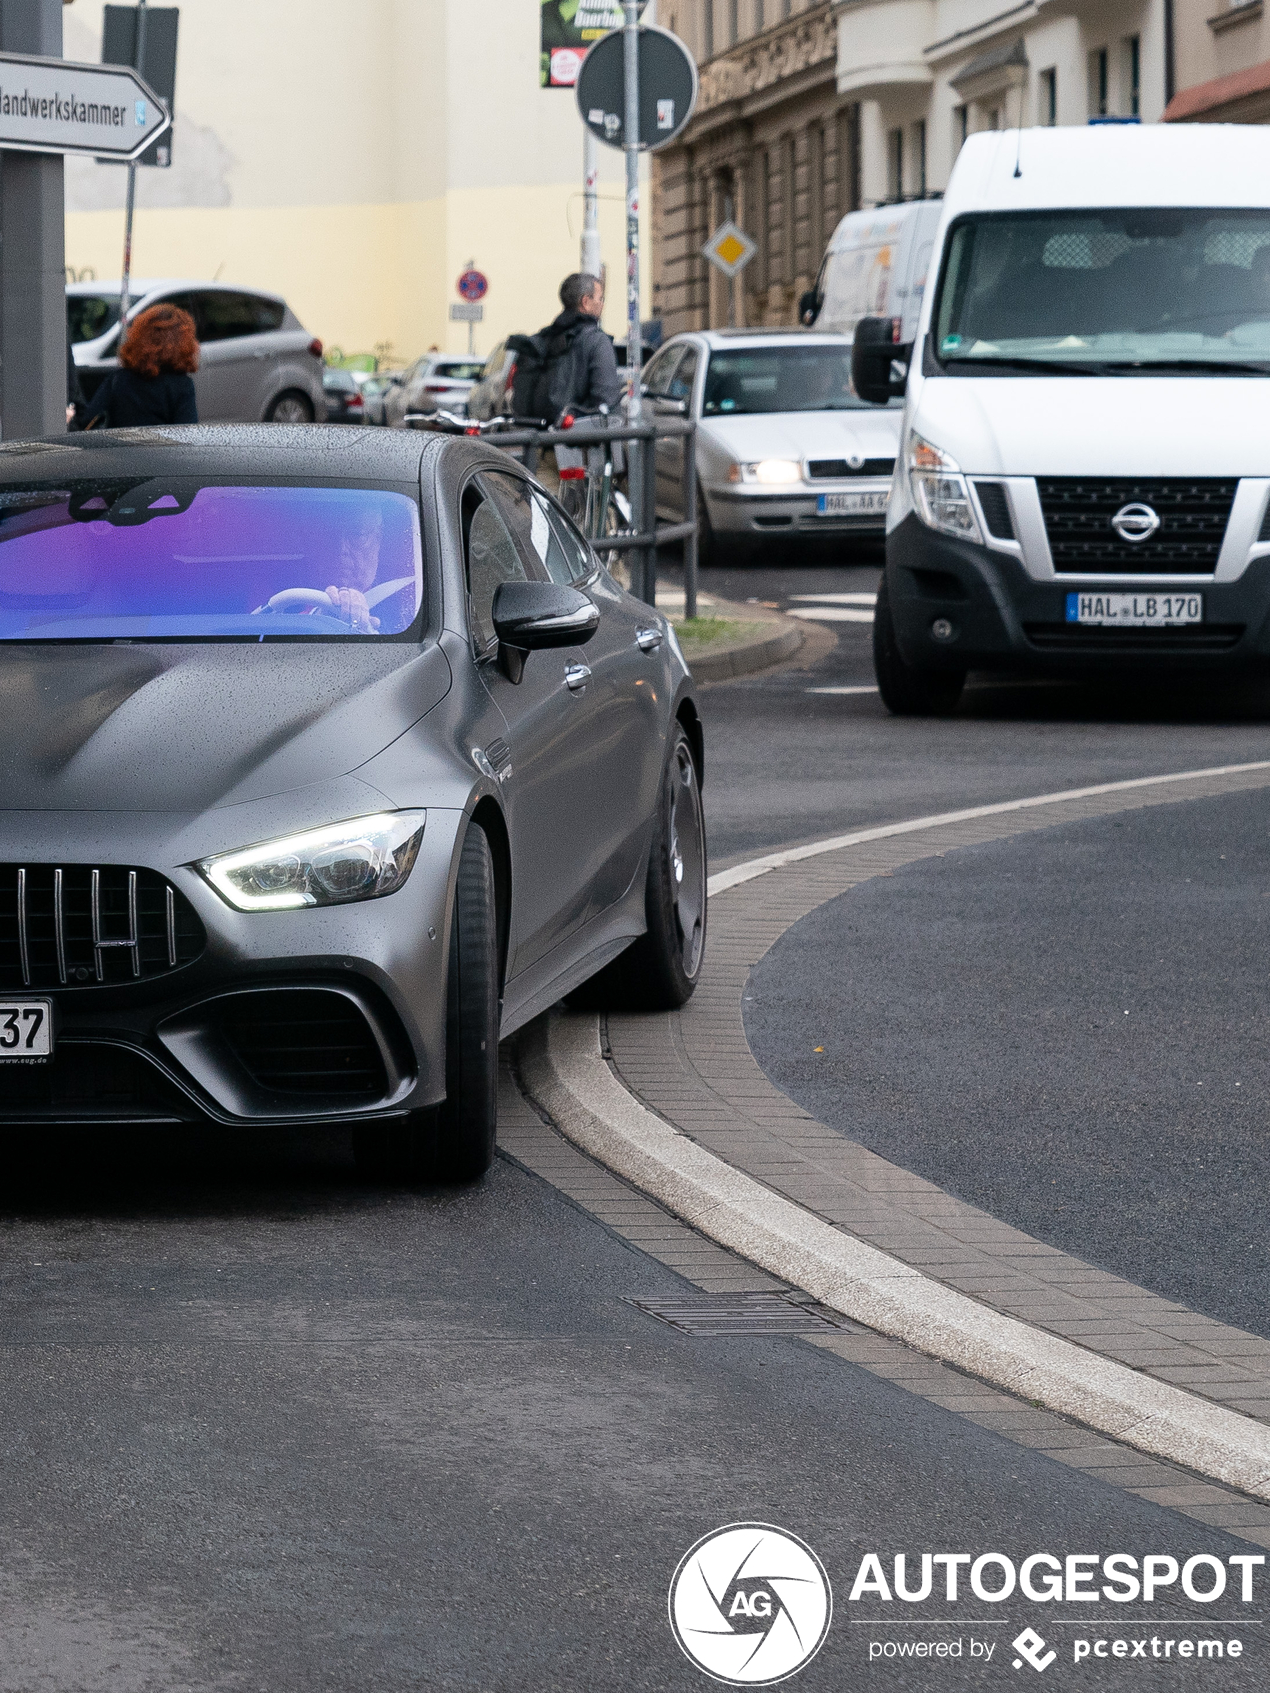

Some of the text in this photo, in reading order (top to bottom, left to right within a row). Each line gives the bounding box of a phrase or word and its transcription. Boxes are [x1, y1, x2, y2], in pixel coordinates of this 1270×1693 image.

[1080, 598, 1199, 618] HAL LB 170
